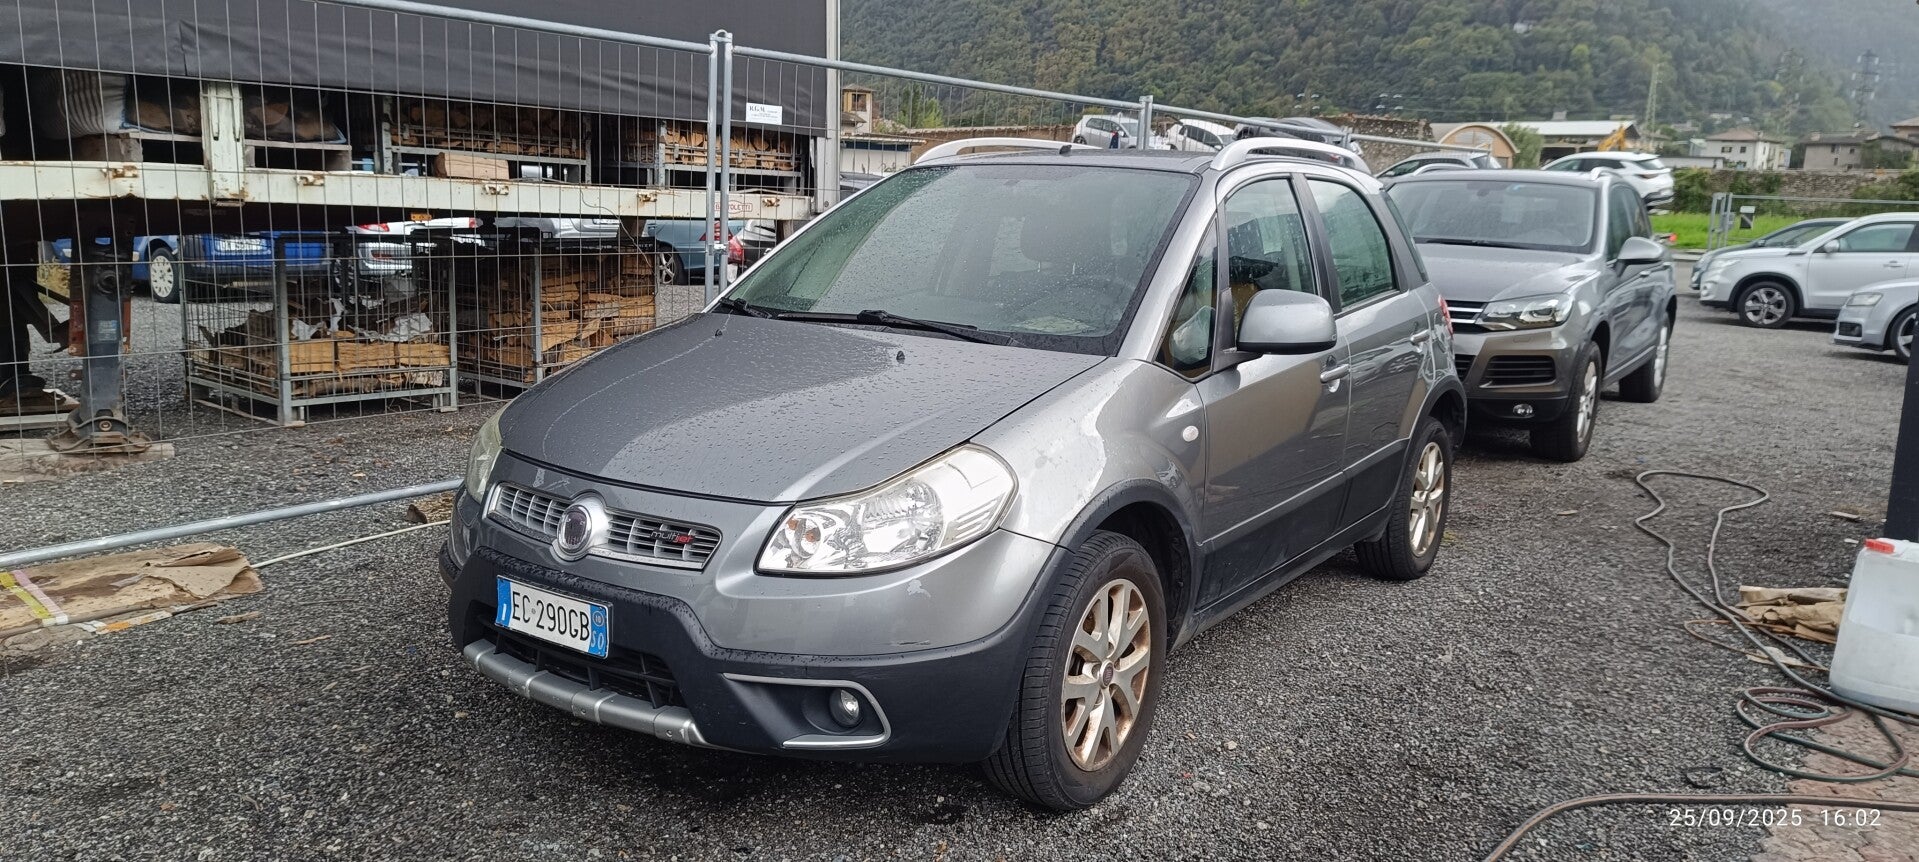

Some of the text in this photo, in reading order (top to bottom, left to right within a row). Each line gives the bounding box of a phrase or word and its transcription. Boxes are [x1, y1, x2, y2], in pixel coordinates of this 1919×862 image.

[650, 531, 693, 543] multijet
[512, 591, 590, 641] EC 290GB
[591, 630, 604, 649] SO
